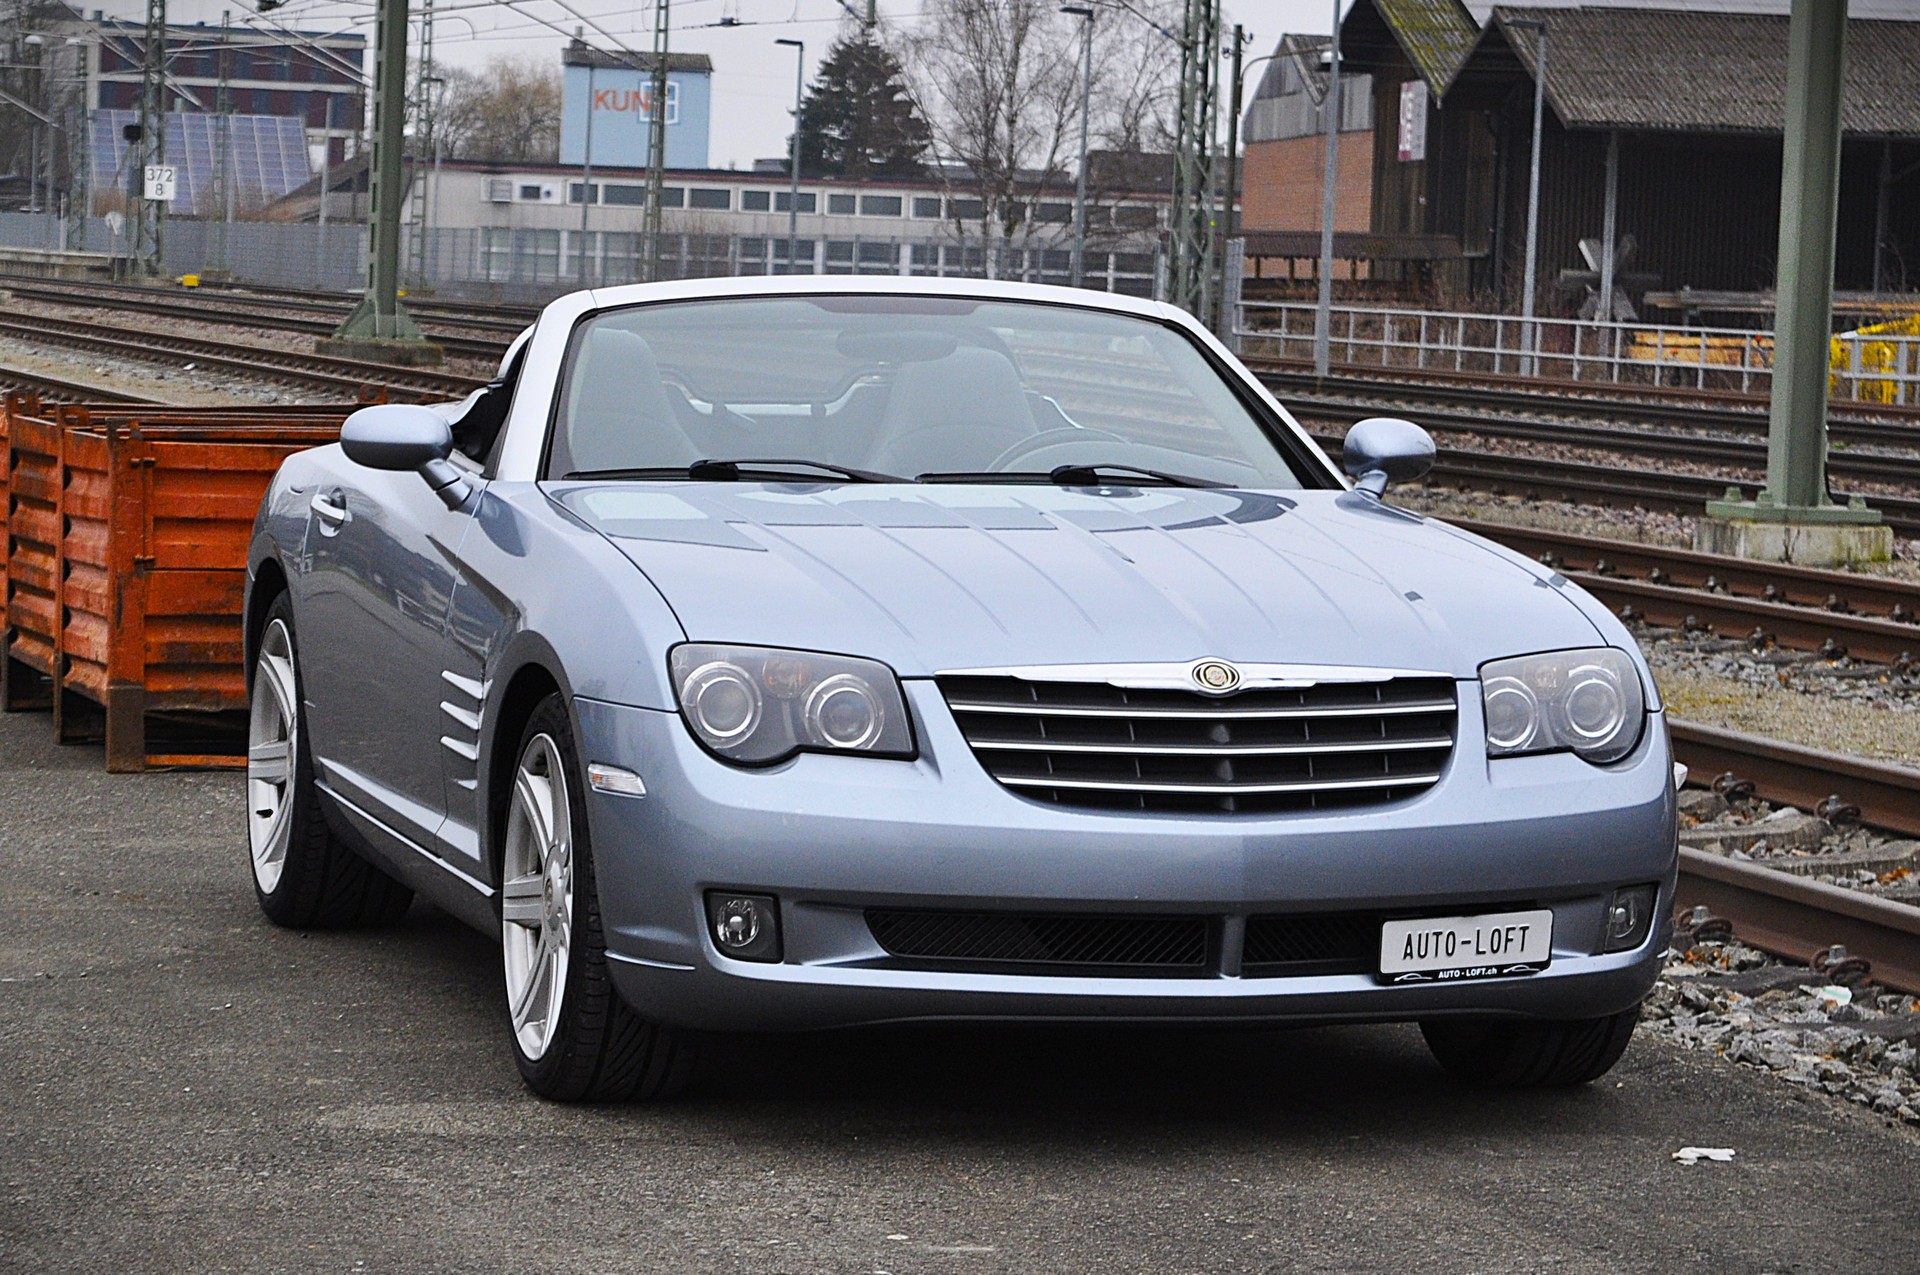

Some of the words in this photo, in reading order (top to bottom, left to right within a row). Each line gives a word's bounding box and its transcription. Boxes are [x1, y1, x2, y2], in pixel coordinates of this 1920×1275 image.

[146, 168, 173, 182] 372
[155, 183, 164, 196] 8
[1403, 925, 1529, 960] AUTO-LOFT
